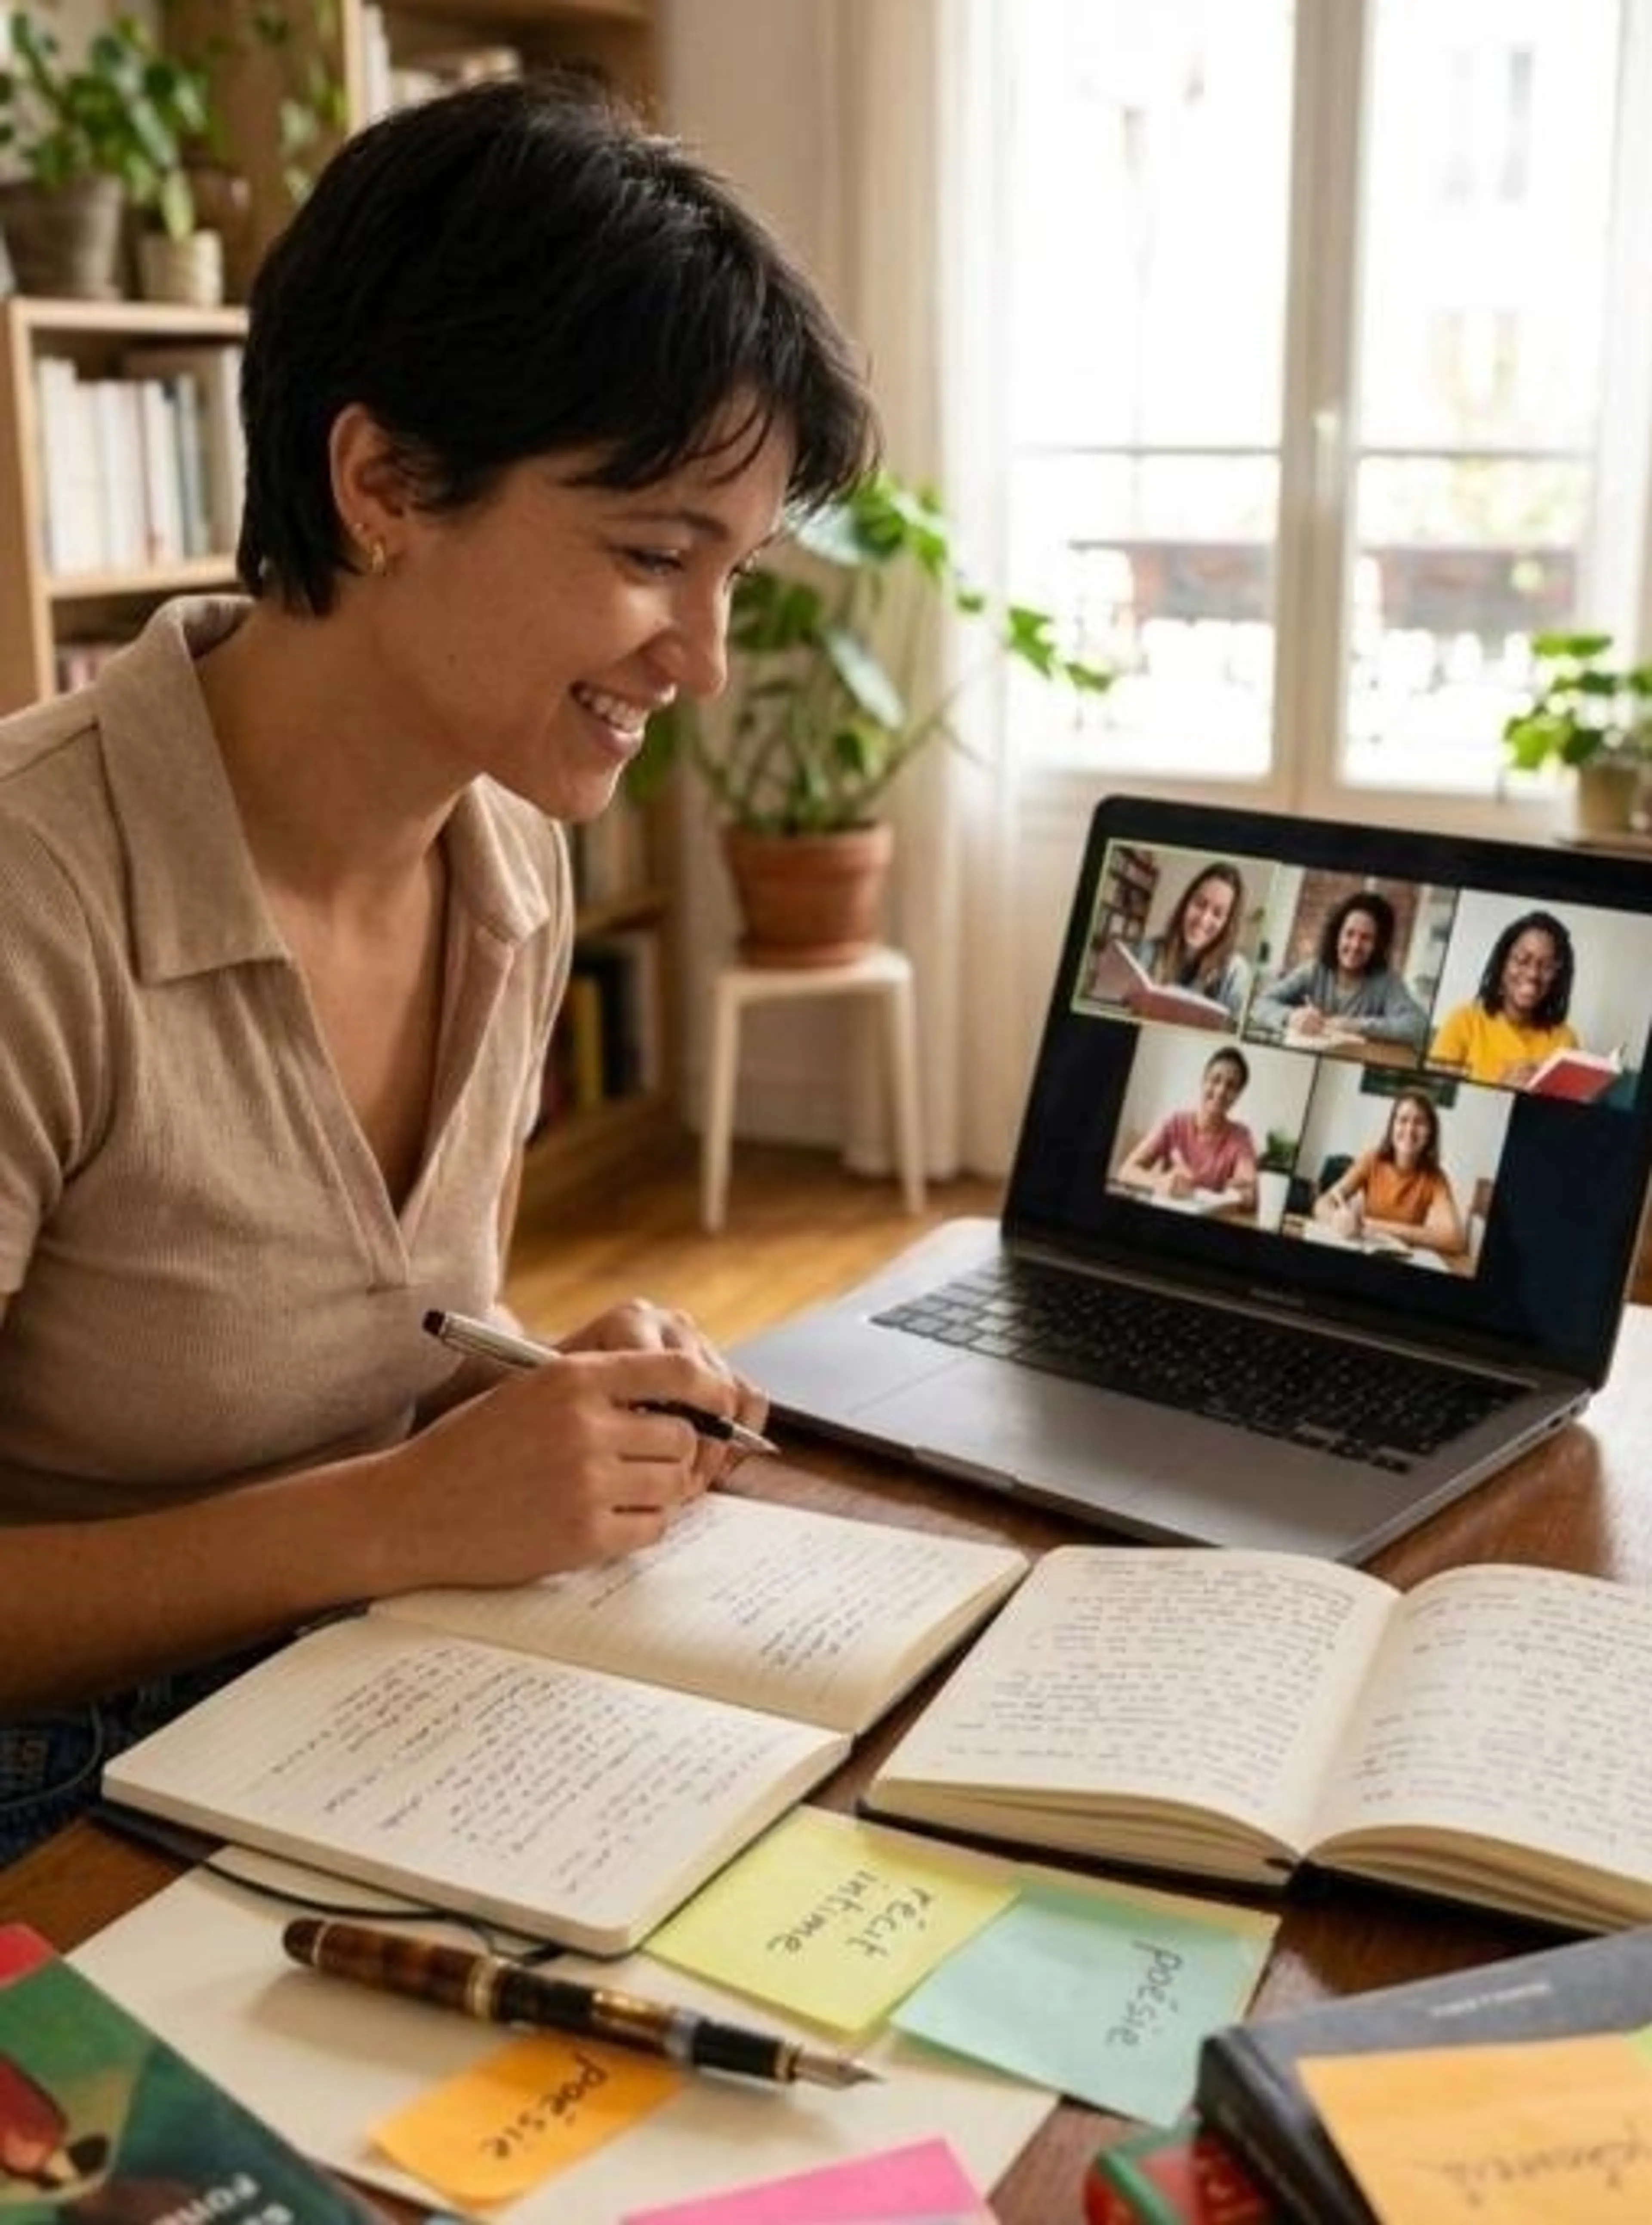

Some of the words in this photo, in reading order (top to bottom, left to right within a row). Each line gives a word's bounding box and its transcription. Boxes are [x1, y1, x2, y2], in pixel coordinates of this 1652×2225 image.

[766, 1869, 891, 1953] intime
[845, 1886, 933, 1959] récit
[1104, 1939, 1184, 2047] poésie
[477, 2049, 608, 2160] poésie
